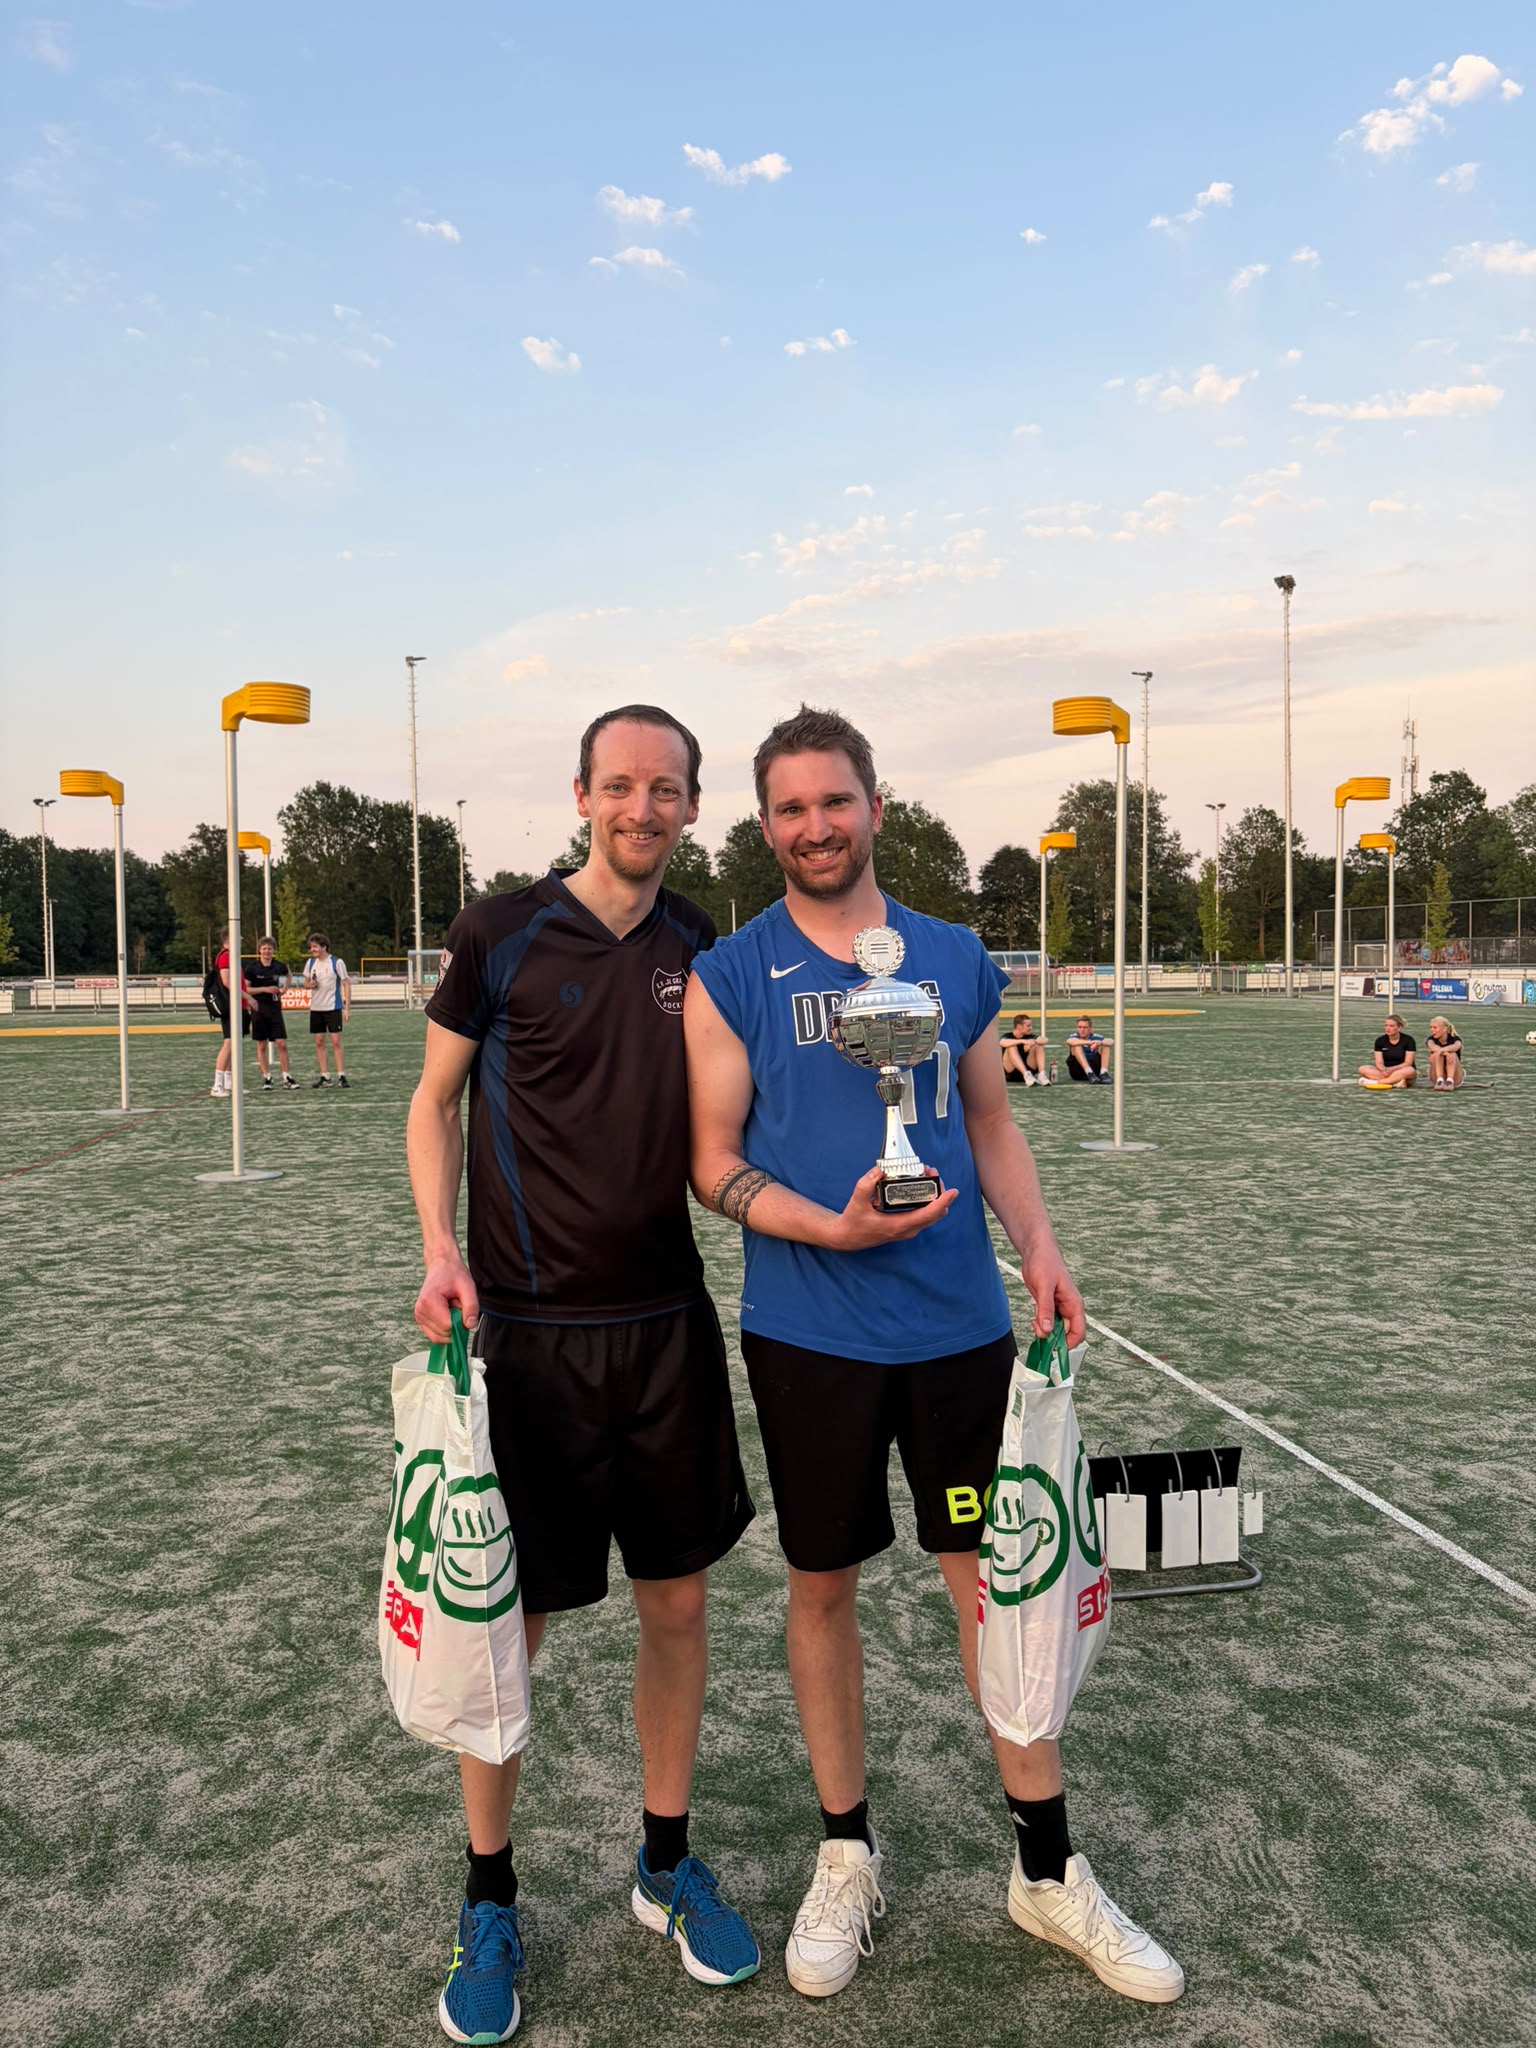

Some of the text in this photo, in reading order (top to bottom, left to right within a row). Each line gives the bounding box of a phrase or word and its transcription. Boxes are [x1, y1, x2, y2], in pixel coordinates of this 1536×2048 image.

[1431, 985, 1453, 993] TALSMA
[1484, 983, 1507, 993] nutma
[946, 1485, 993, 1524] B
